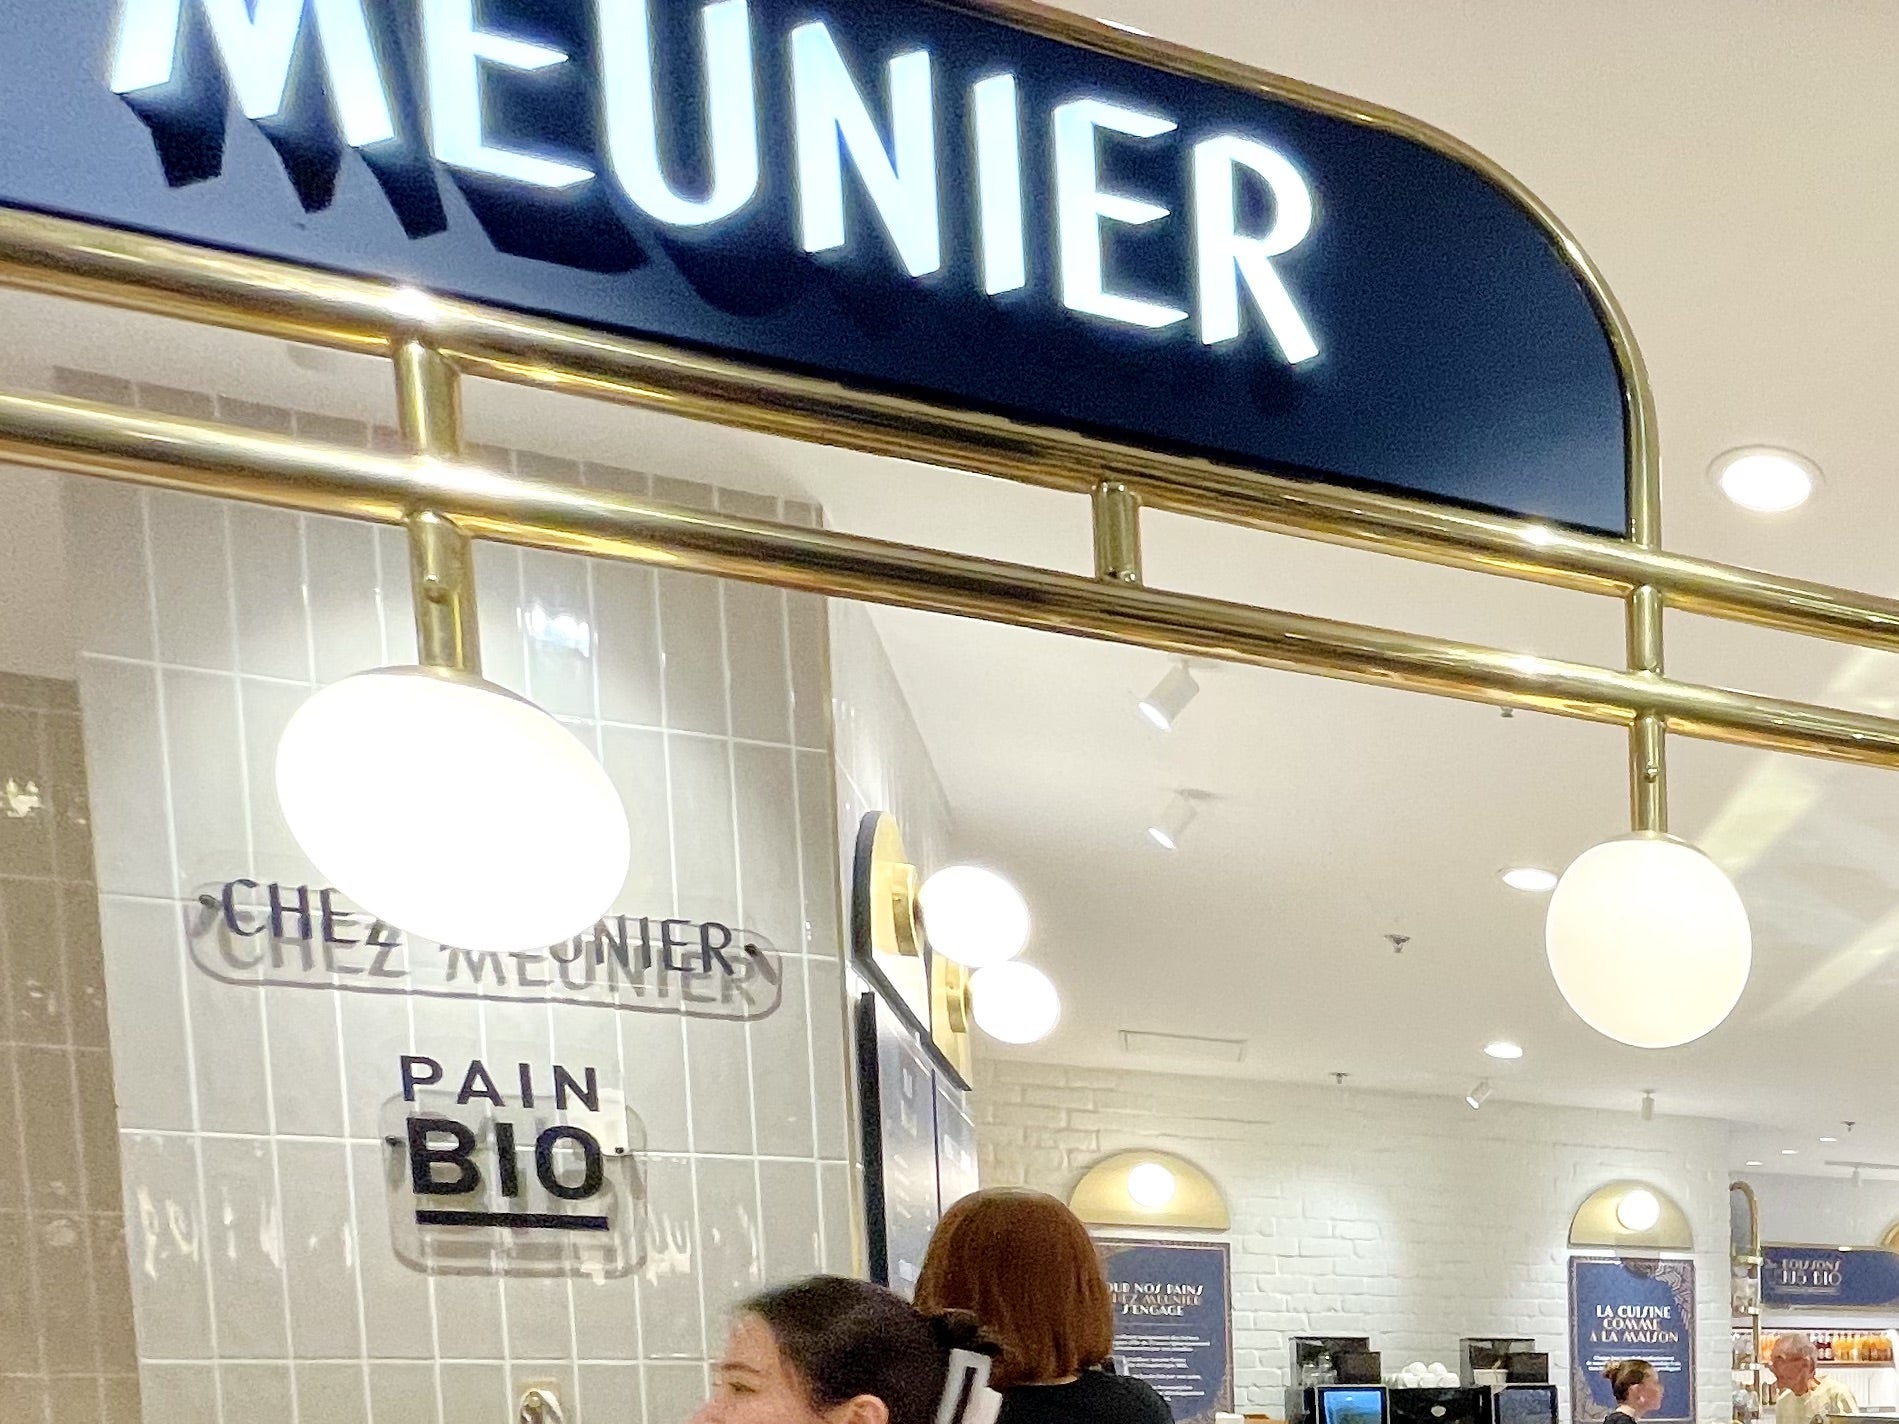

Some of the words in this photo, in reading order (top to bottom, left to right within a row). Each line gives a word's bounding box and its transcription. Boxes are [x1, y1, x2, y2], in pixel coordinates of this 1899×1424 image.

[108, 0, 1322, 364] MEUNIER
[399, 1055, 600, 1112] PAIN
[406, 1117, 606, 1200] BIO
[1596, 1304, 1614, 1318] LA
[1618, 1305, 1672, 1319] CUISINE
[1603, 1317, 1660, 1331] COMME
[1601, 1330, 1619, 1342] LA
[1623, 1331, 1680, 1343] MAISON
